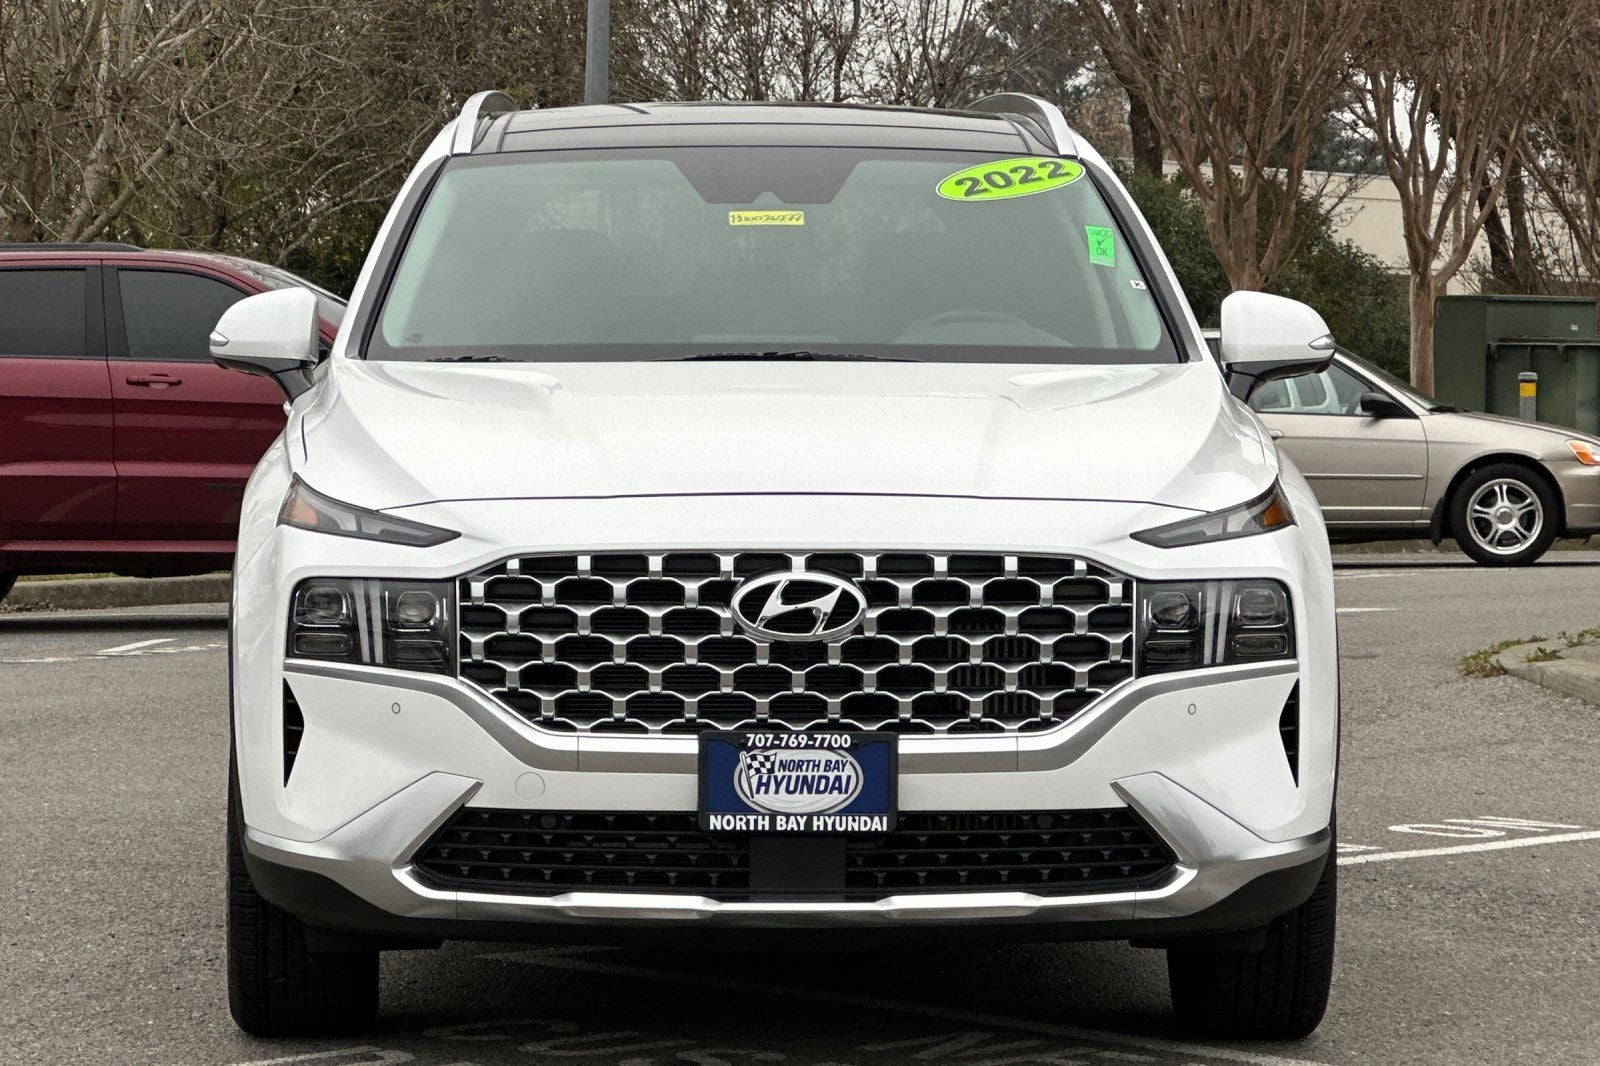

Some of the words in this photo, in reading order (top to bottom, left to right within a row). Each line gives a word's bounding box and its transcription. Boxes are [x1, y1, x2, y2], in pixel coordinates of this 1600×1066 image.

[955, 160, 1074, 197] 2022
[746, 734, 852, 748] 707-769-7700
[778, 759, 821, 773] NORTH
[823, 759, 849, 773] BAY
[755, 774, 852, 795] HYUNDAI
[709, 815, 770, 831] NORTH
[776, 815, 808, 831] BAY
[812, 815, 888, 832] HYUNDAI
